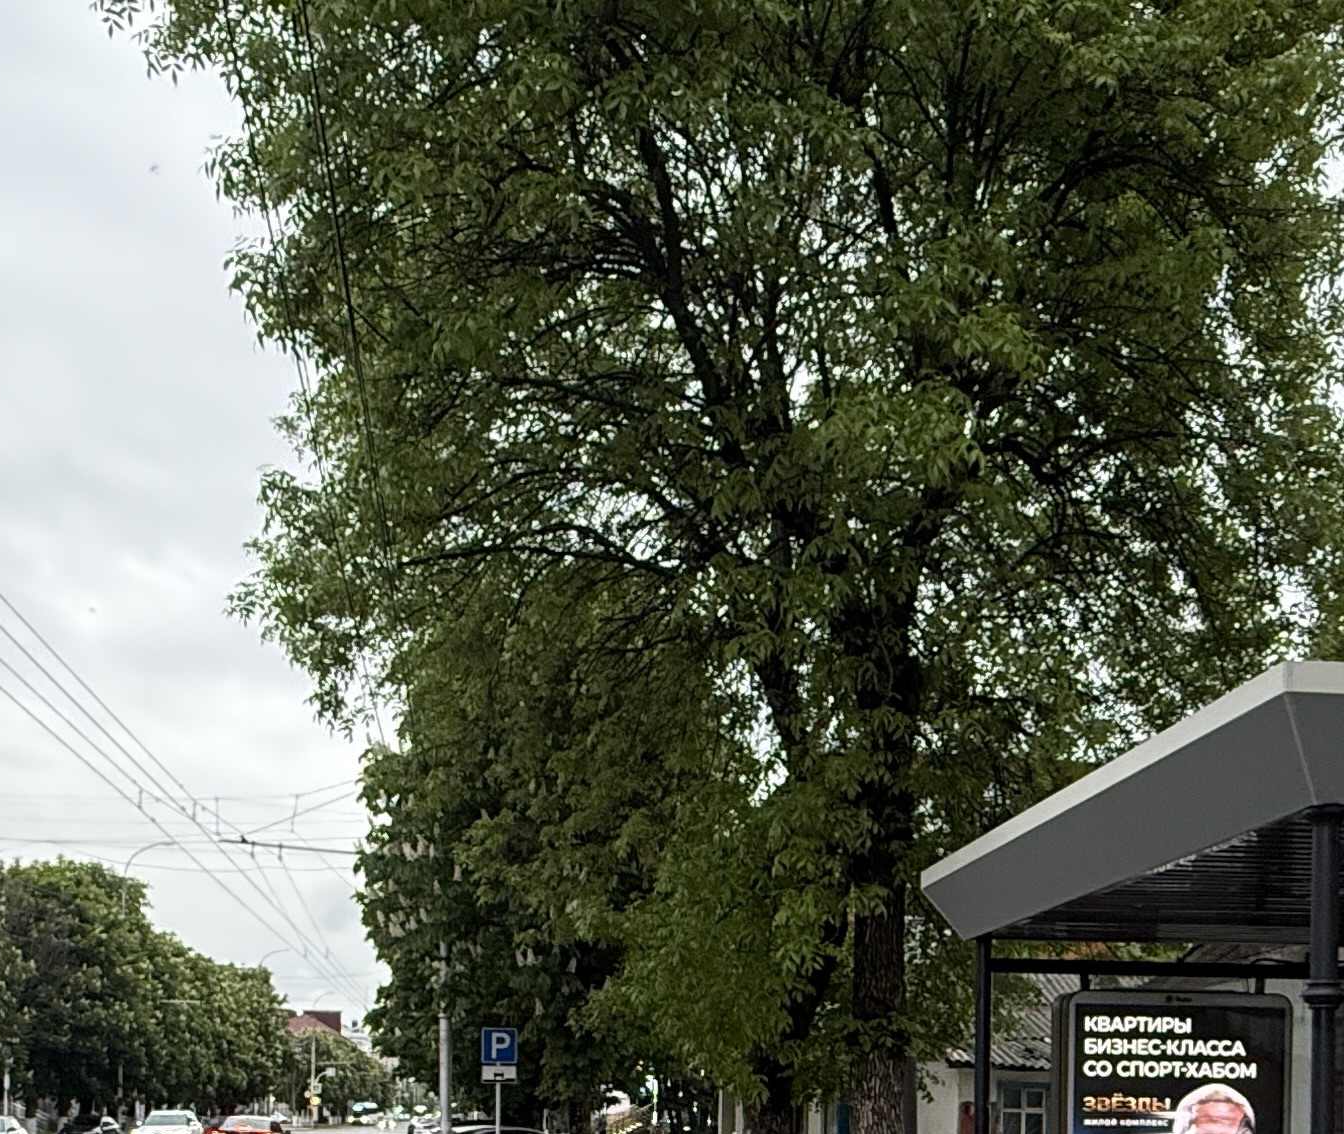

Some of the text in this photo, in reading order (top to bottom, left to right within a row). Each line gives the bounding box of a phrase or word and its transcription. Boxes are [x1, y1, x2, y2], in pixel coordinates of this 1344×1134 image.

[1084, 1016, 1193, 1034] КВАРТИРЫ
[1083, 1038, 1247, 1056] БИЗНЕС-КЛАССА
[1083, 1060, 1258, 1079] СО СПОРТ-ХАБОМ
[1082, 1092, 1171, 1112] ЗВЁЗДЫ
